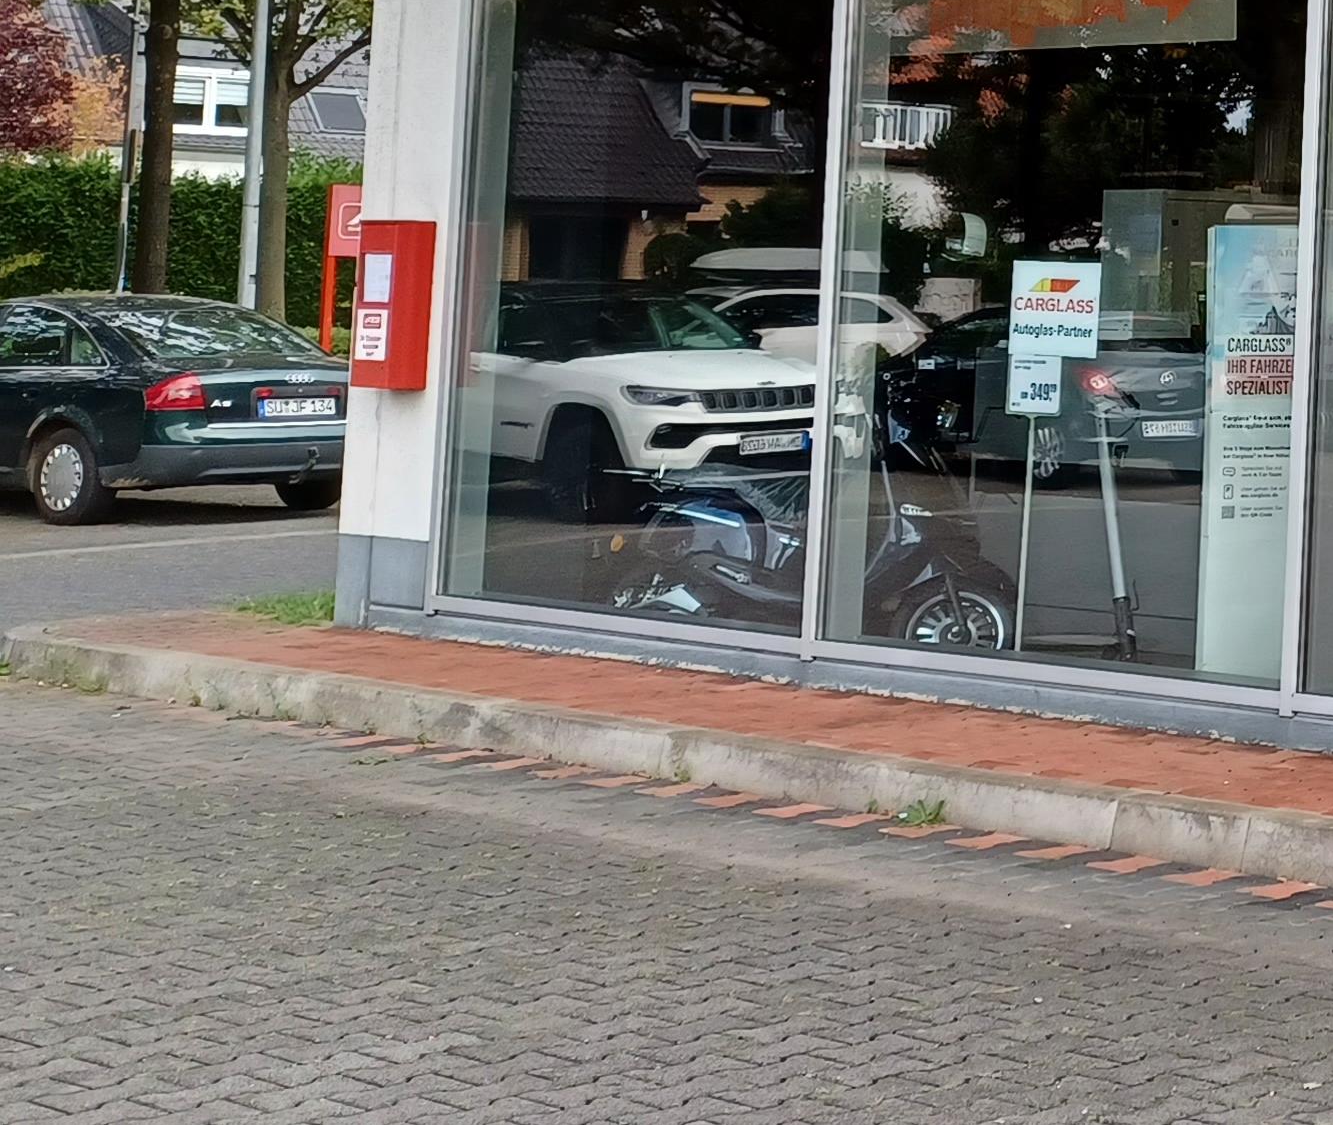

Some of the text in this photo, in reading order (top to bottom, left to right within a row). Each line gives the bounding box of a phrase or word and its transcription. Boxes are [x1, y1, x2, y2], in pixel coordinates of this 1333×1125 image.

[1014, 297, 1094, 314] CARGLASS
[1013, 323, 1093, 338] Autoglas-Partner
[1227, 359, 1247, 374] IHR
[1226, 380, 1290, 395] SPEZIALIST
[311, 399, 333, 412] 134
